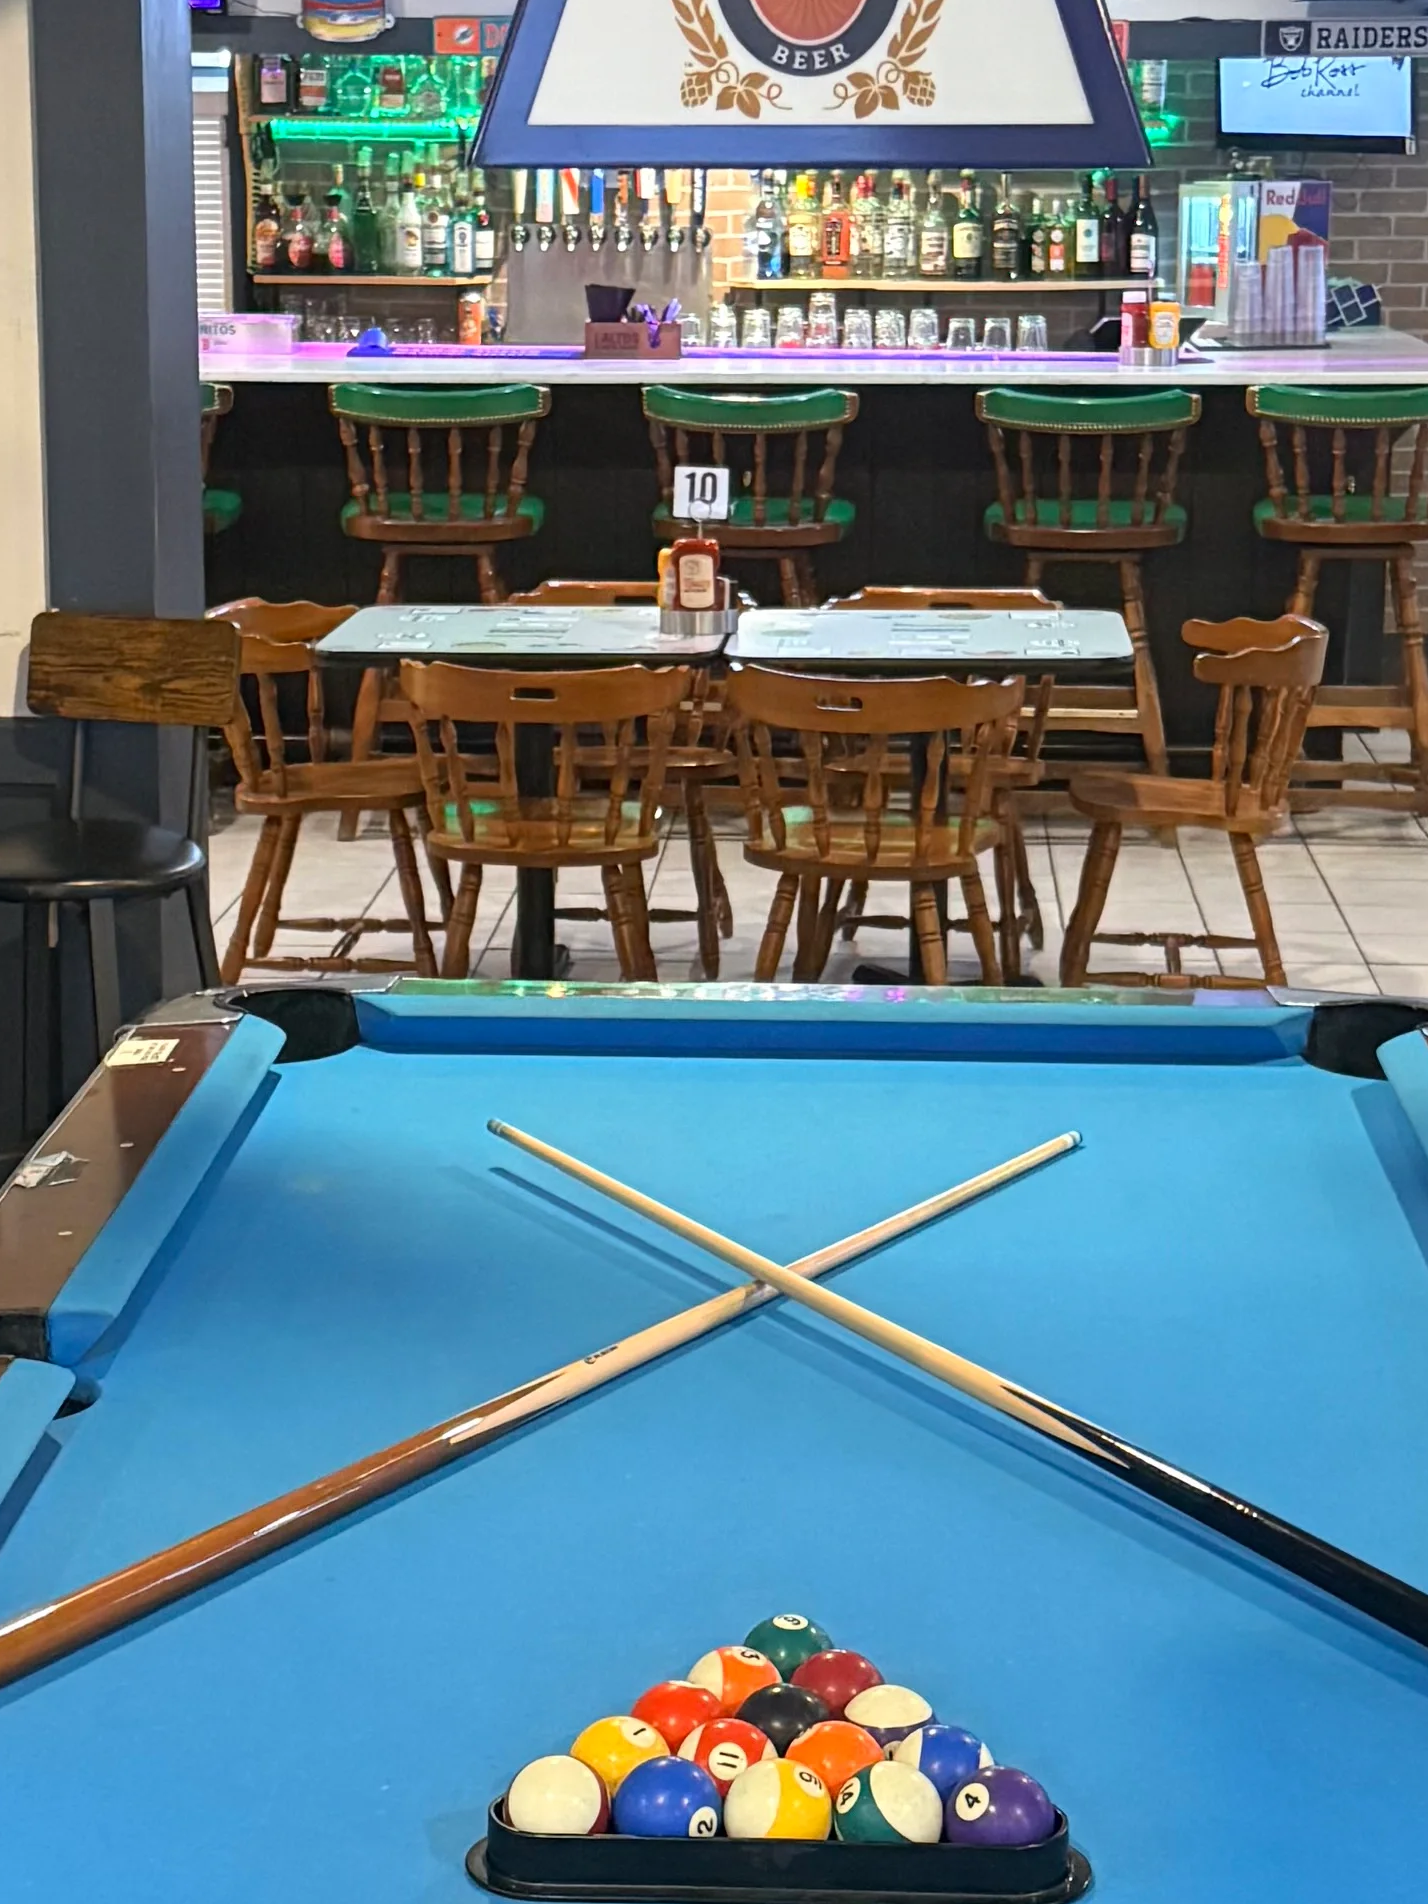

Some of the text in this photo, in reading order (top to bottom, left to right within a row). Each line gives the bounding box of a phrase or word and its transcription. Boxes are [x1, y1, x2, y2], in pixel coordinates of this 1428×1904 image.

[1316, 25, 1428, 49] RAIDERS
[771, 42, 851, 70] BEER
[1261, 56, 1313, 88] Bob
[1301, 85, 1360, 98] channel
[1265, 189, 1295, 207] Red
[684, 472, 718, 505] 10
[740, 1649, 761, 1662] 3
[717, 1751, 740, 1769] 11
[839, 1783, 854, 1807] 14
[965, 1793, 982, 1809] 4
[697, 1817, 714, 1835] 2
